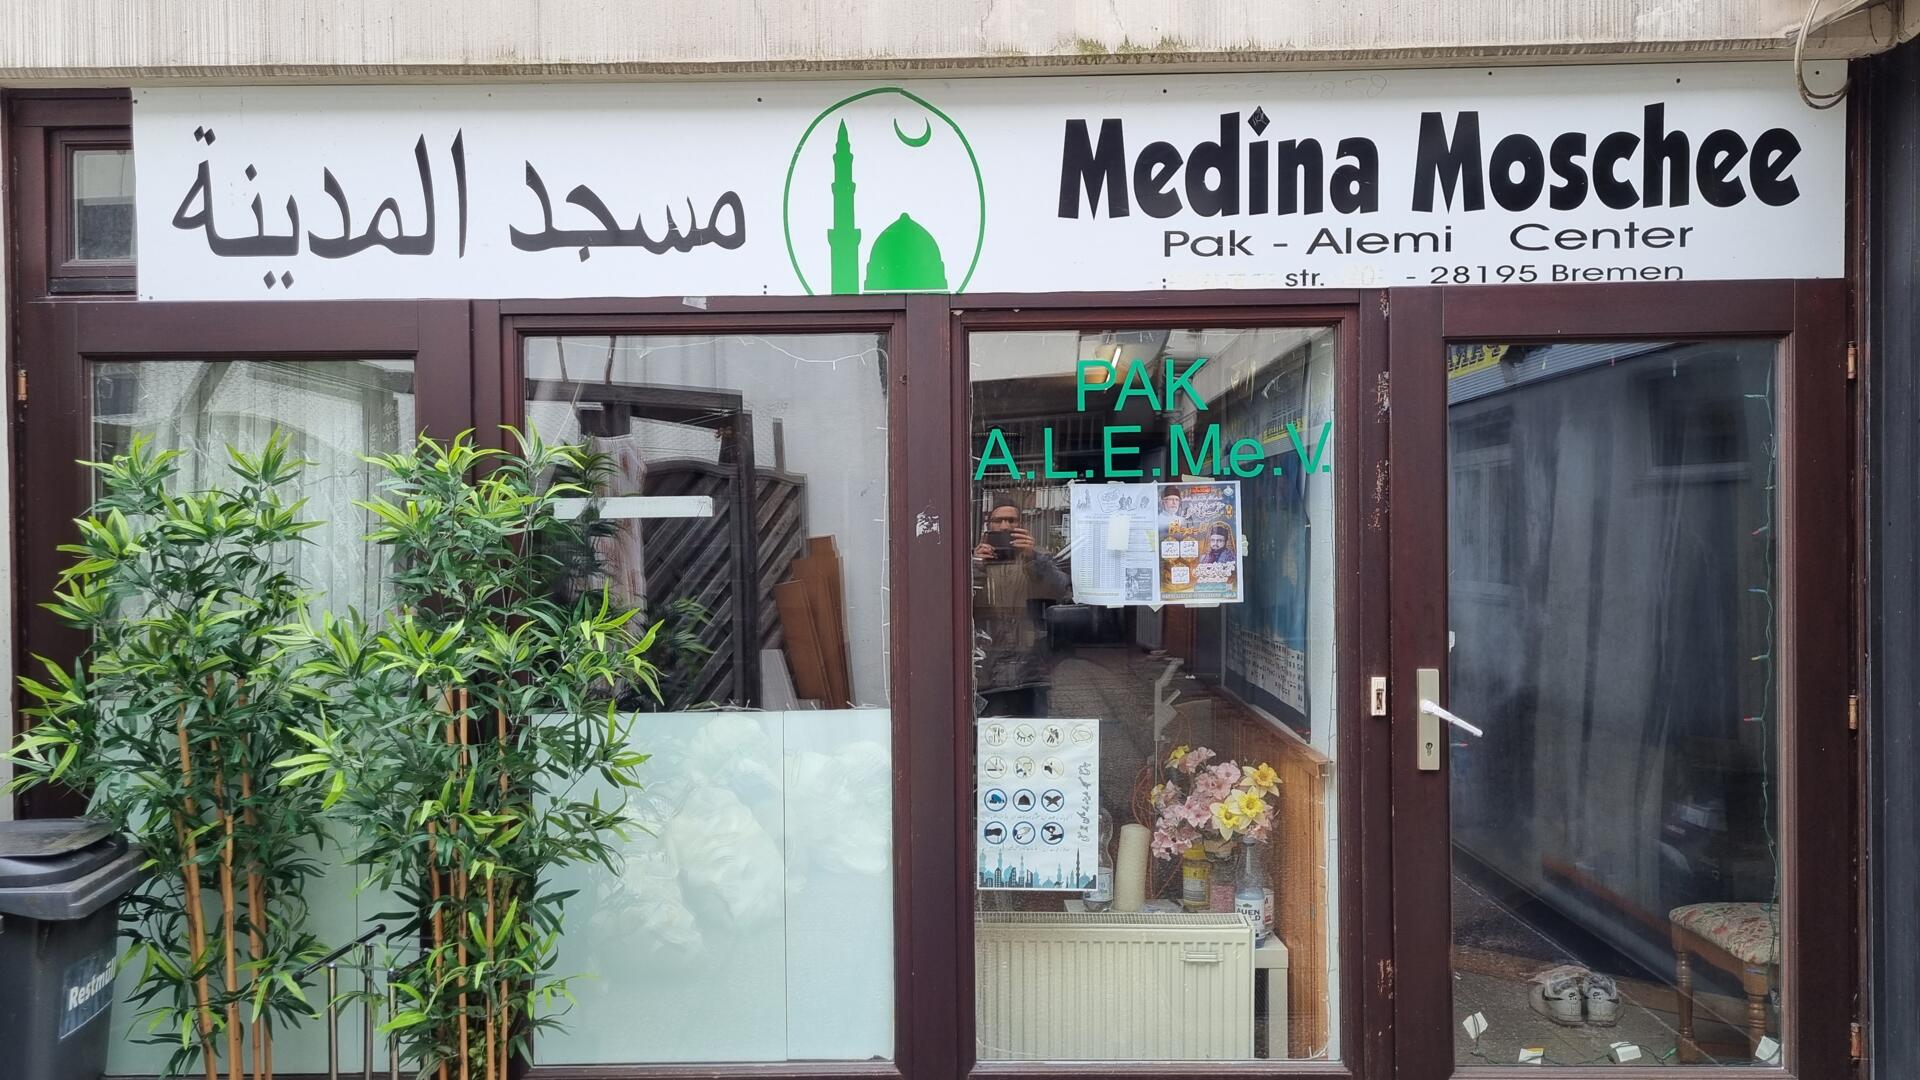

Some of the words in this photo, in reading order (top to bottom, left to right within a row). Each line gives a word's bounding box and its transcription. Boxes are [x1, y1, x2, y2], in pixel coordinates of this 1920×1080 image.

[1057, 105, 1379, 220] Medina
[1411, 102, 1802, 214] Moschee
[172, 125, 467, 289] المدينة
[510, 160, 746, 262] مسجد
[1164, 229, 1254, 258] Pak
[1305, 226, 1452, 255] Alemi
[1509, 221, 1694, 252] Center
[1285, 268, 1325, 287] str.
[1430, 264, 1538, 285] 28195
[1552, 264, 1684, 282] Bremen
[1076, 357, 1208, 412] PAK
